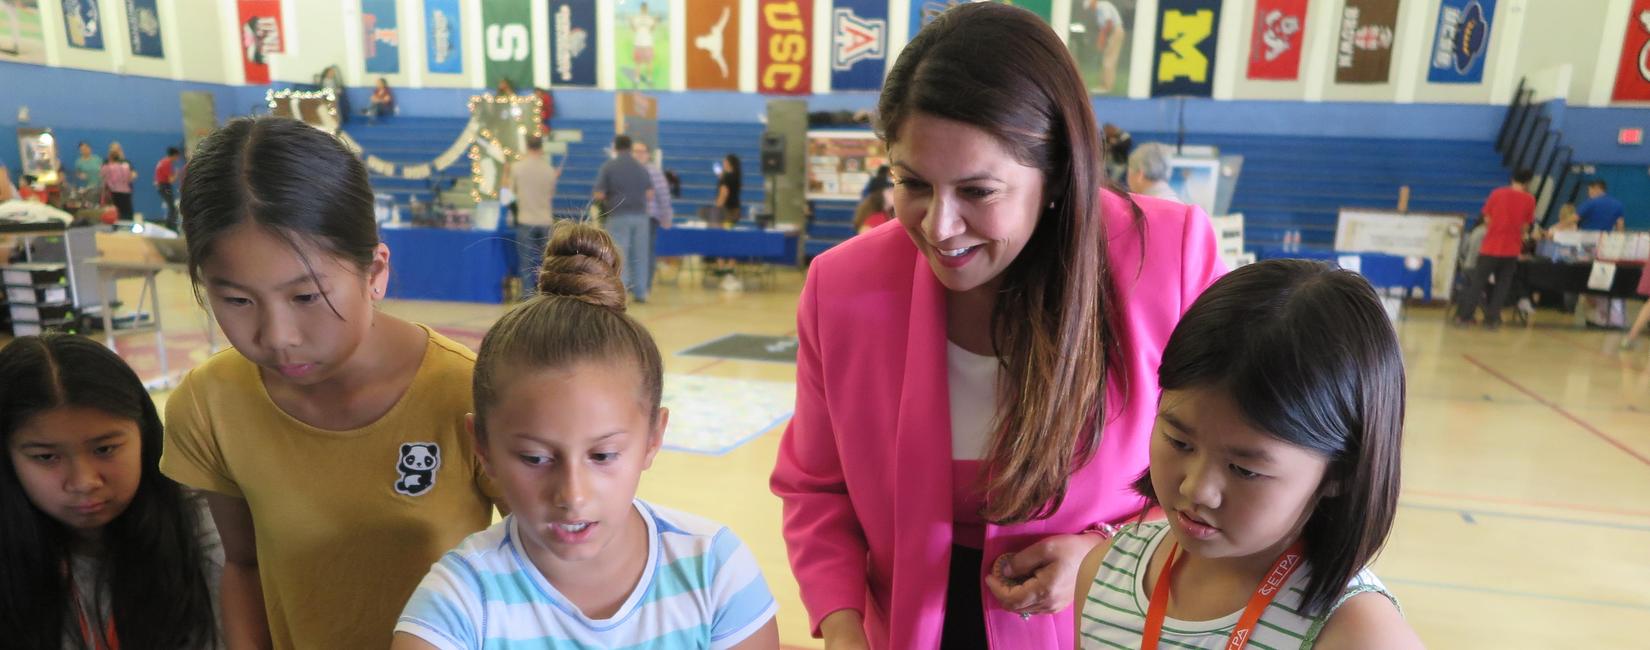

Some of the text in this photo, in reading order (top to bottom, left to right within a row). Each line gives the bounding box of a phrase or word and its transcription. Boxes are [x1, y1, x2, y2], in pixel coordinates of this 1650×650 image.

[486, 23, 529, 62] S
[763, 1, 806, 91] USC
[833, 8, 885, 71] A
[1157, 9, 1214, 84] M
[1338, 6, 1361, 69] BROWN
